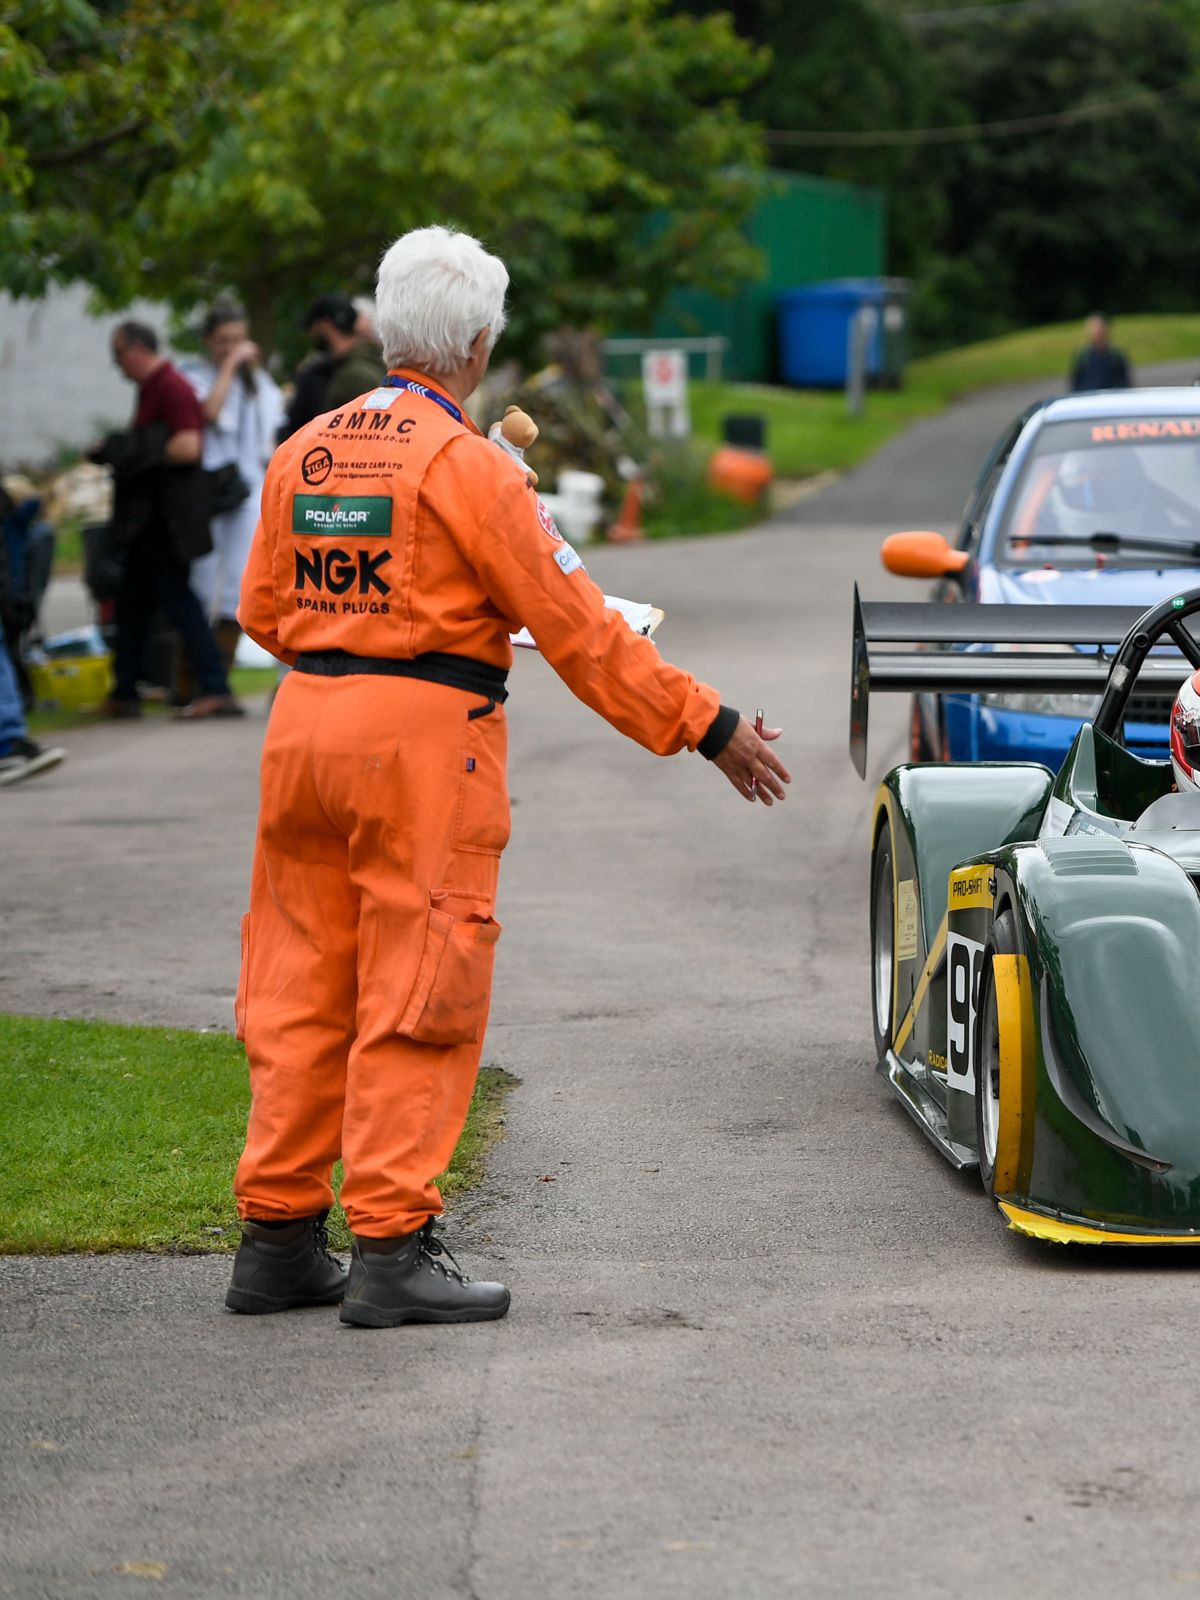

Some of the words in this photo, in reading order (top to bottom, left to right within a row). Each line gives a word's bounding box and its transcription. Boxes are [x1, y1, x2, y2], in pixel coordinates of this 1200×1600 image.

[317, 431, 411, 444] www.marshals.co.uk
[305, 457, 330, 475] TIGA
[333, 461, 349, 469] TIGA
[350, 461, 367, 469] RACE
[368, 461, 386, 469] CARS
[388, 462, 403, 470] LTD
[293, 546, 393, 598] NGK
[296, 597, 337, 614] SPARK
[342, 602, 390, 614] PLUGS
